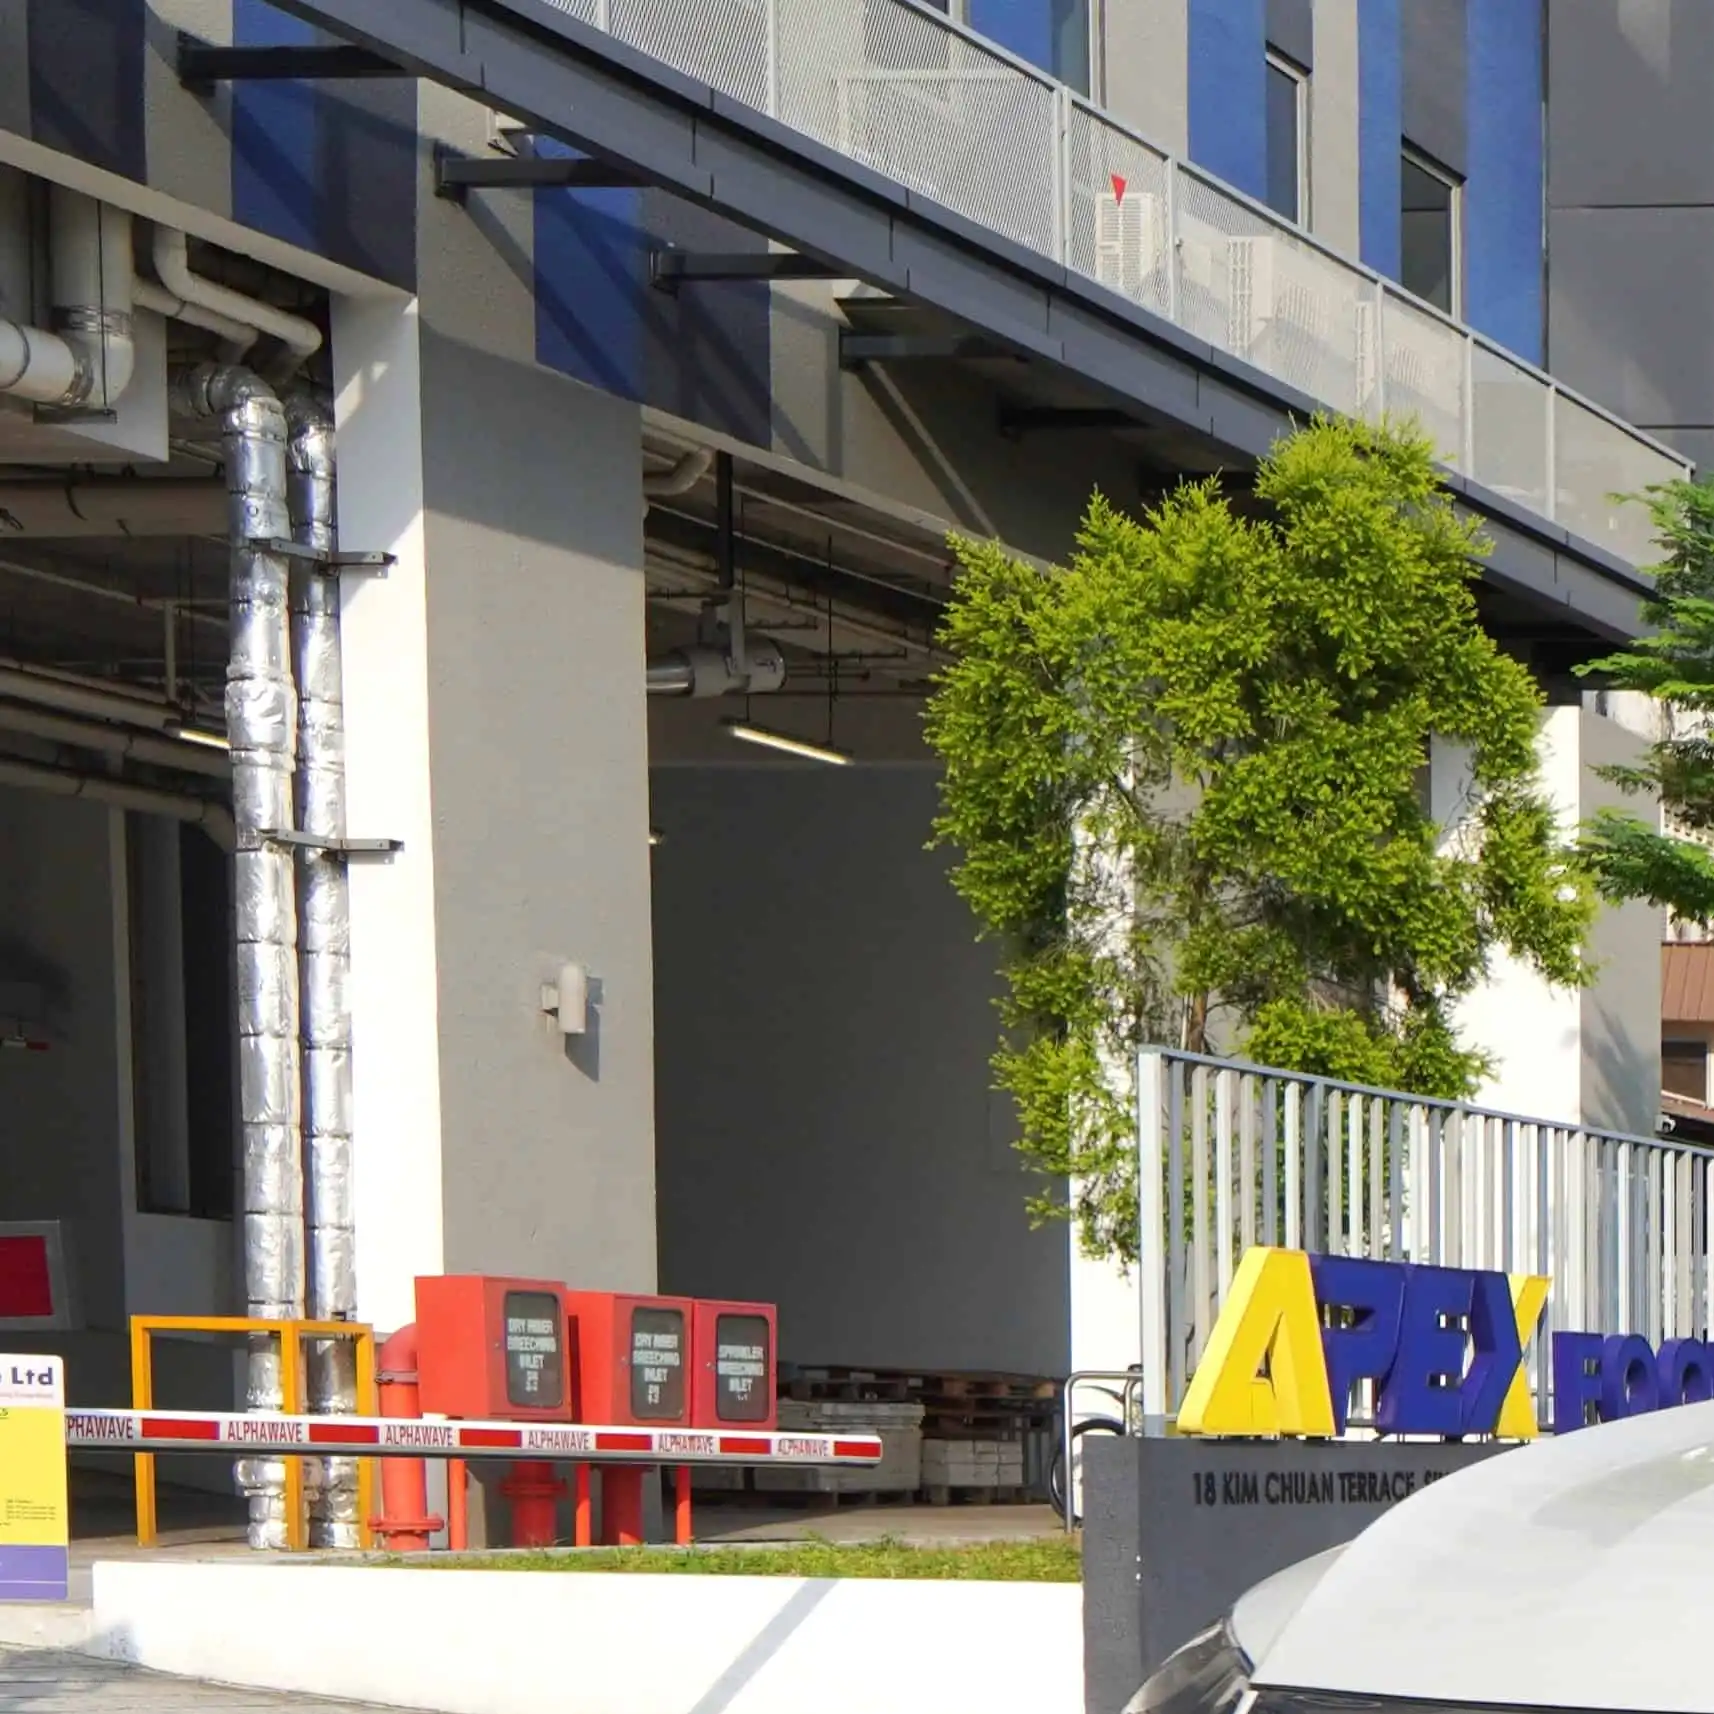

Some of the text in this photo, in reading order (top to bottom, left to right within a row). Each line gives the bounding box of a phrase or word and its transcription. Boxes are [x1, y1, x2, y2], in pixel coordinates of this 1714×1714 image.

[1178, 1246, 1553, 1440] APEX
[11, 1366, 54, 1386] Ltd
[65, 1414, 134, 1440] PHAWAVE
[226, 1421, 303, 1443] ALPHAWAVE
[384, 1425, 454, 1447] ALPHAWAVE
[527, 1430, 591, 1452] ALPHAWAVE
[657, 1433, 715, 1455] ALPHAWAVE
[776, 1437, 830, 1458] ALPHAWAVE
[1192, 1470, 1217, 1506] 18
[1222, 1470, 1259, 1505] KIM
[1263, 1470, 1335, 1505] CHUAN
[1338, 1471, 1416, 1504] TERRACE
